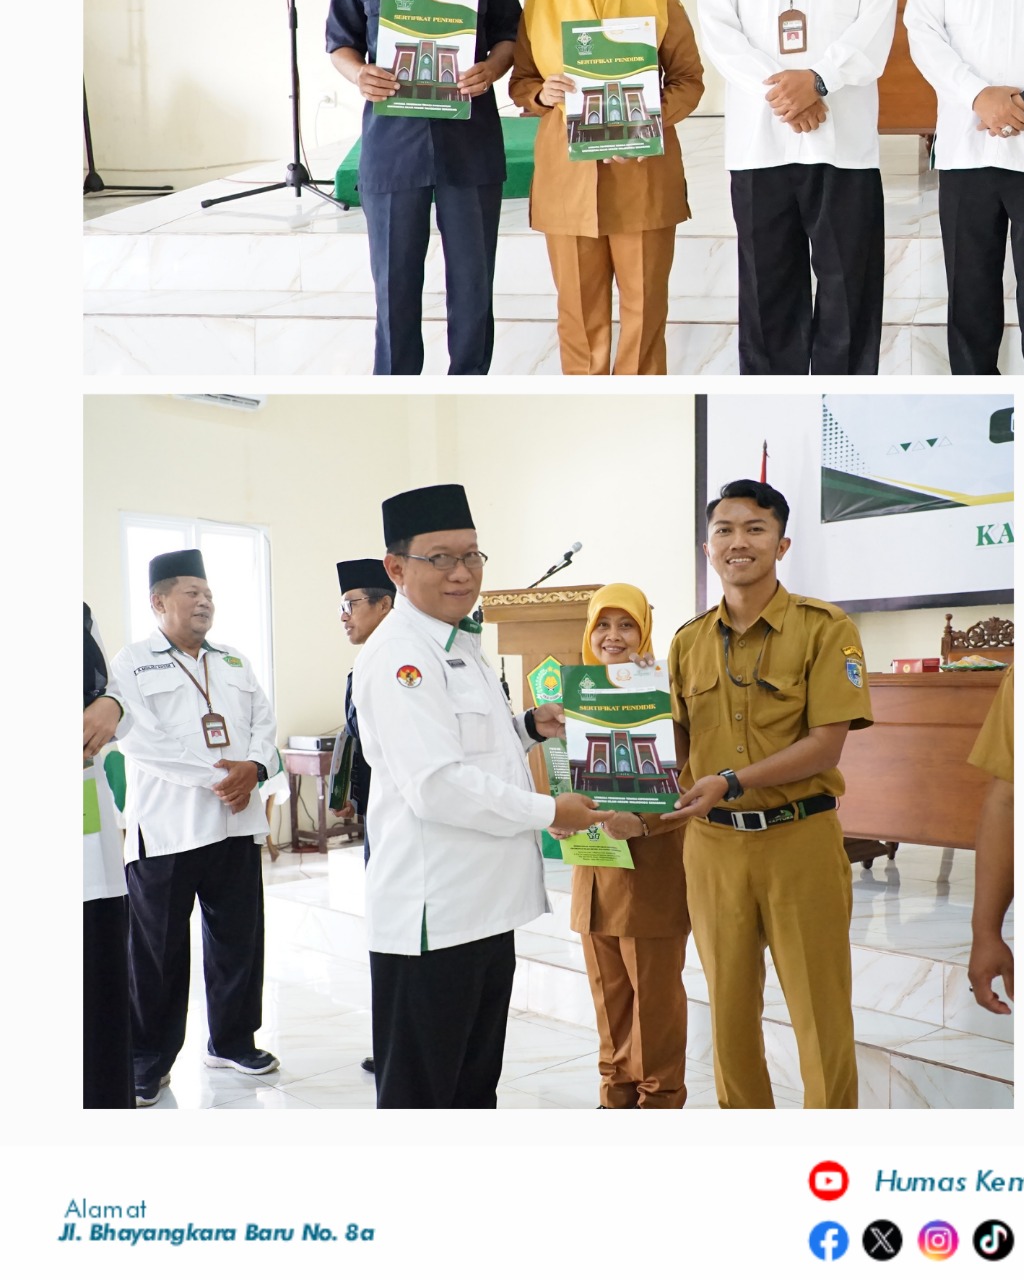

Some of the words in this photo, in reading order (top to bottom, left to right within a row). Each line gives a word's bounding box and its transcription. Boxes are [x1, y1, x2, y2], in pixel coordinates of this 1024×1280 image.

[393, 14, 431, 22] SERTIFIKAT
[432, 16, 464, 24] PENDIDIK
[621, 703, 657, 711] PENDIDIK
